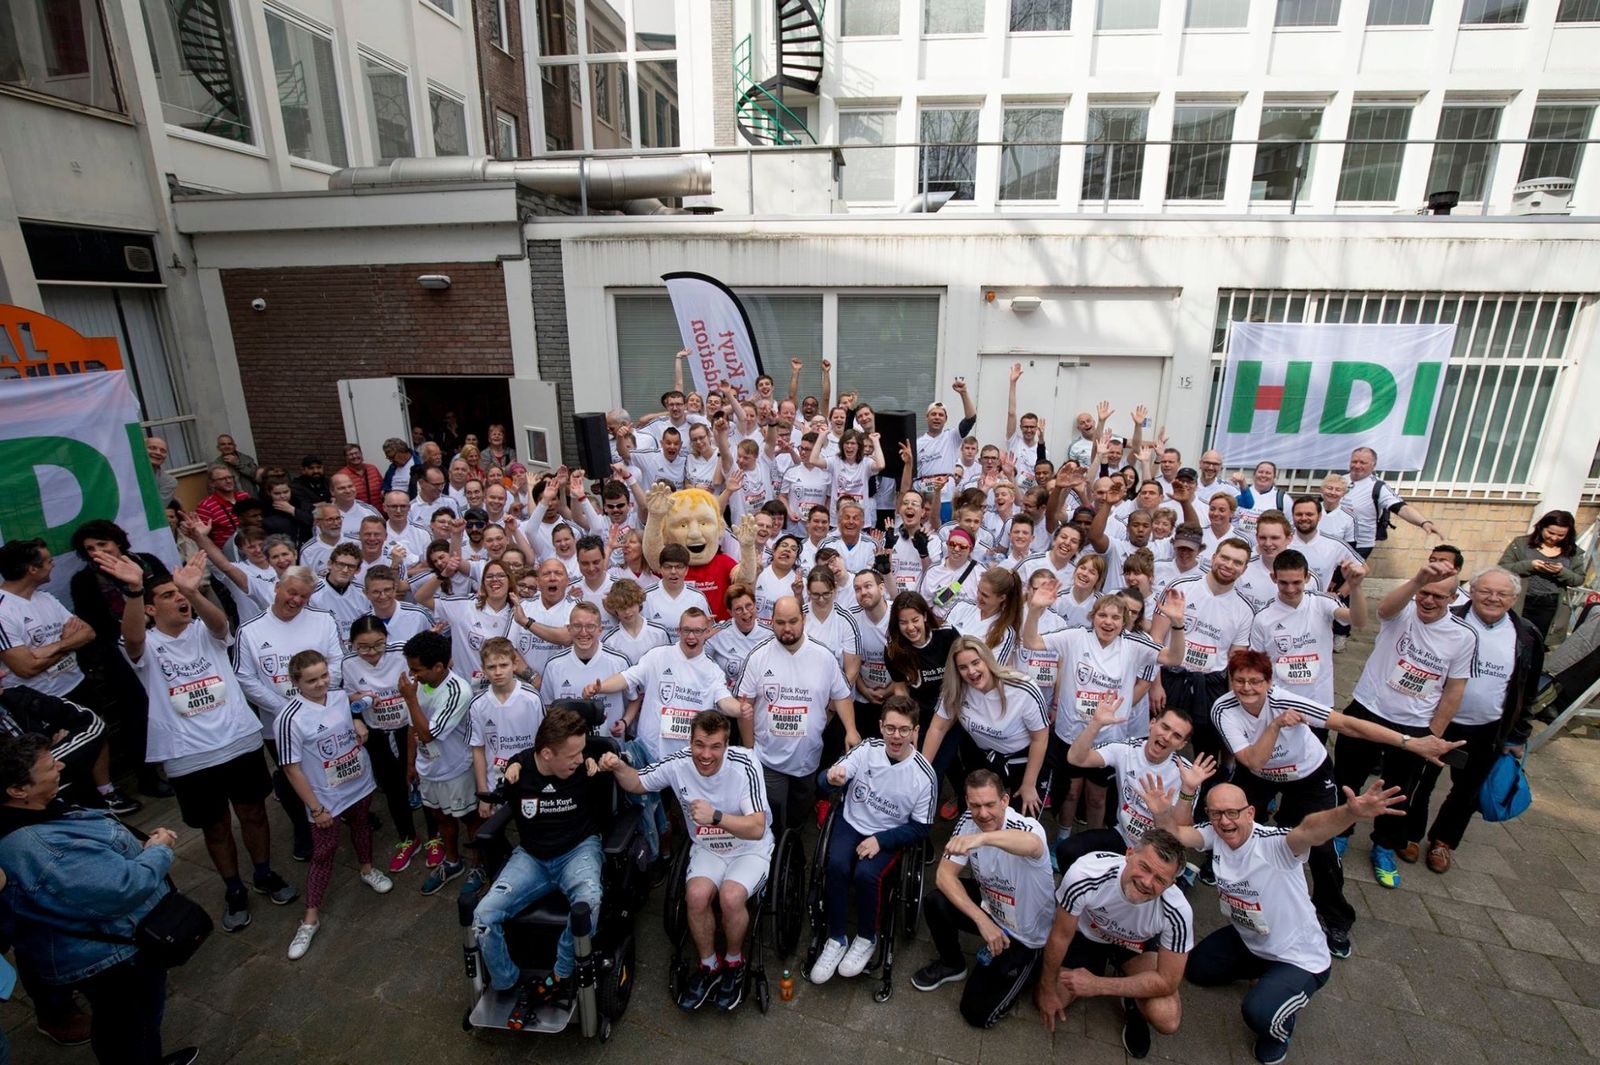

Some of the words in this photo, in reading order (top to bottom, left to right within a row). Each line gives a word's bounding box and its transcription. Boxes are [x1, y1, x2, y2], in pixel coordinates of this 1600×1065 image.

[1180, 375, 1192, 387] 15
[1227, 360, 1442, 436] HDI
[1186, 648, 1208, 659] RUBEN
[1408, 644, 1422, 655] Dirk
[1425, 651, 1442, 664] Kuyt
[1289, 662, 1308, 670] NICK
[1406, 650, 1444, 672] Foundation
[1485, 661, 1504, 671] Kuyt
[1480, 669, 1507, 679] ndation
[186, 680, 205, 691] CITY
[780, 686, 794, 694] Dirk
[794, 687, 809, 696] Kuyt
[188, 687, 210, 700] ARIE
[780, 694, 813, 703] Foundation
[187, 694, 215, 709] 40179
[772, 713, 803, 722] MAURICE
[775, 721, 799, 731] 40290
[970, 720, 985, 731] Dirk
[986, 725, 1003, 736] Kuyt
[500, 735, 514, 744] Dirk
[515, 734, 532, 743] Kuyt
[540, 800, 555, 808] Dirk
[556, 797, 572, 807] Kuyt
[866, 797, 901, 819] Foundation
[883, 799, 899, 811] Kuyt
[540, 804, 577, 814] Foundation
[700, 826, 708, 835] AD
[709, 826, 723, 834] CITY
[709, 841, 733, 849] 40314
